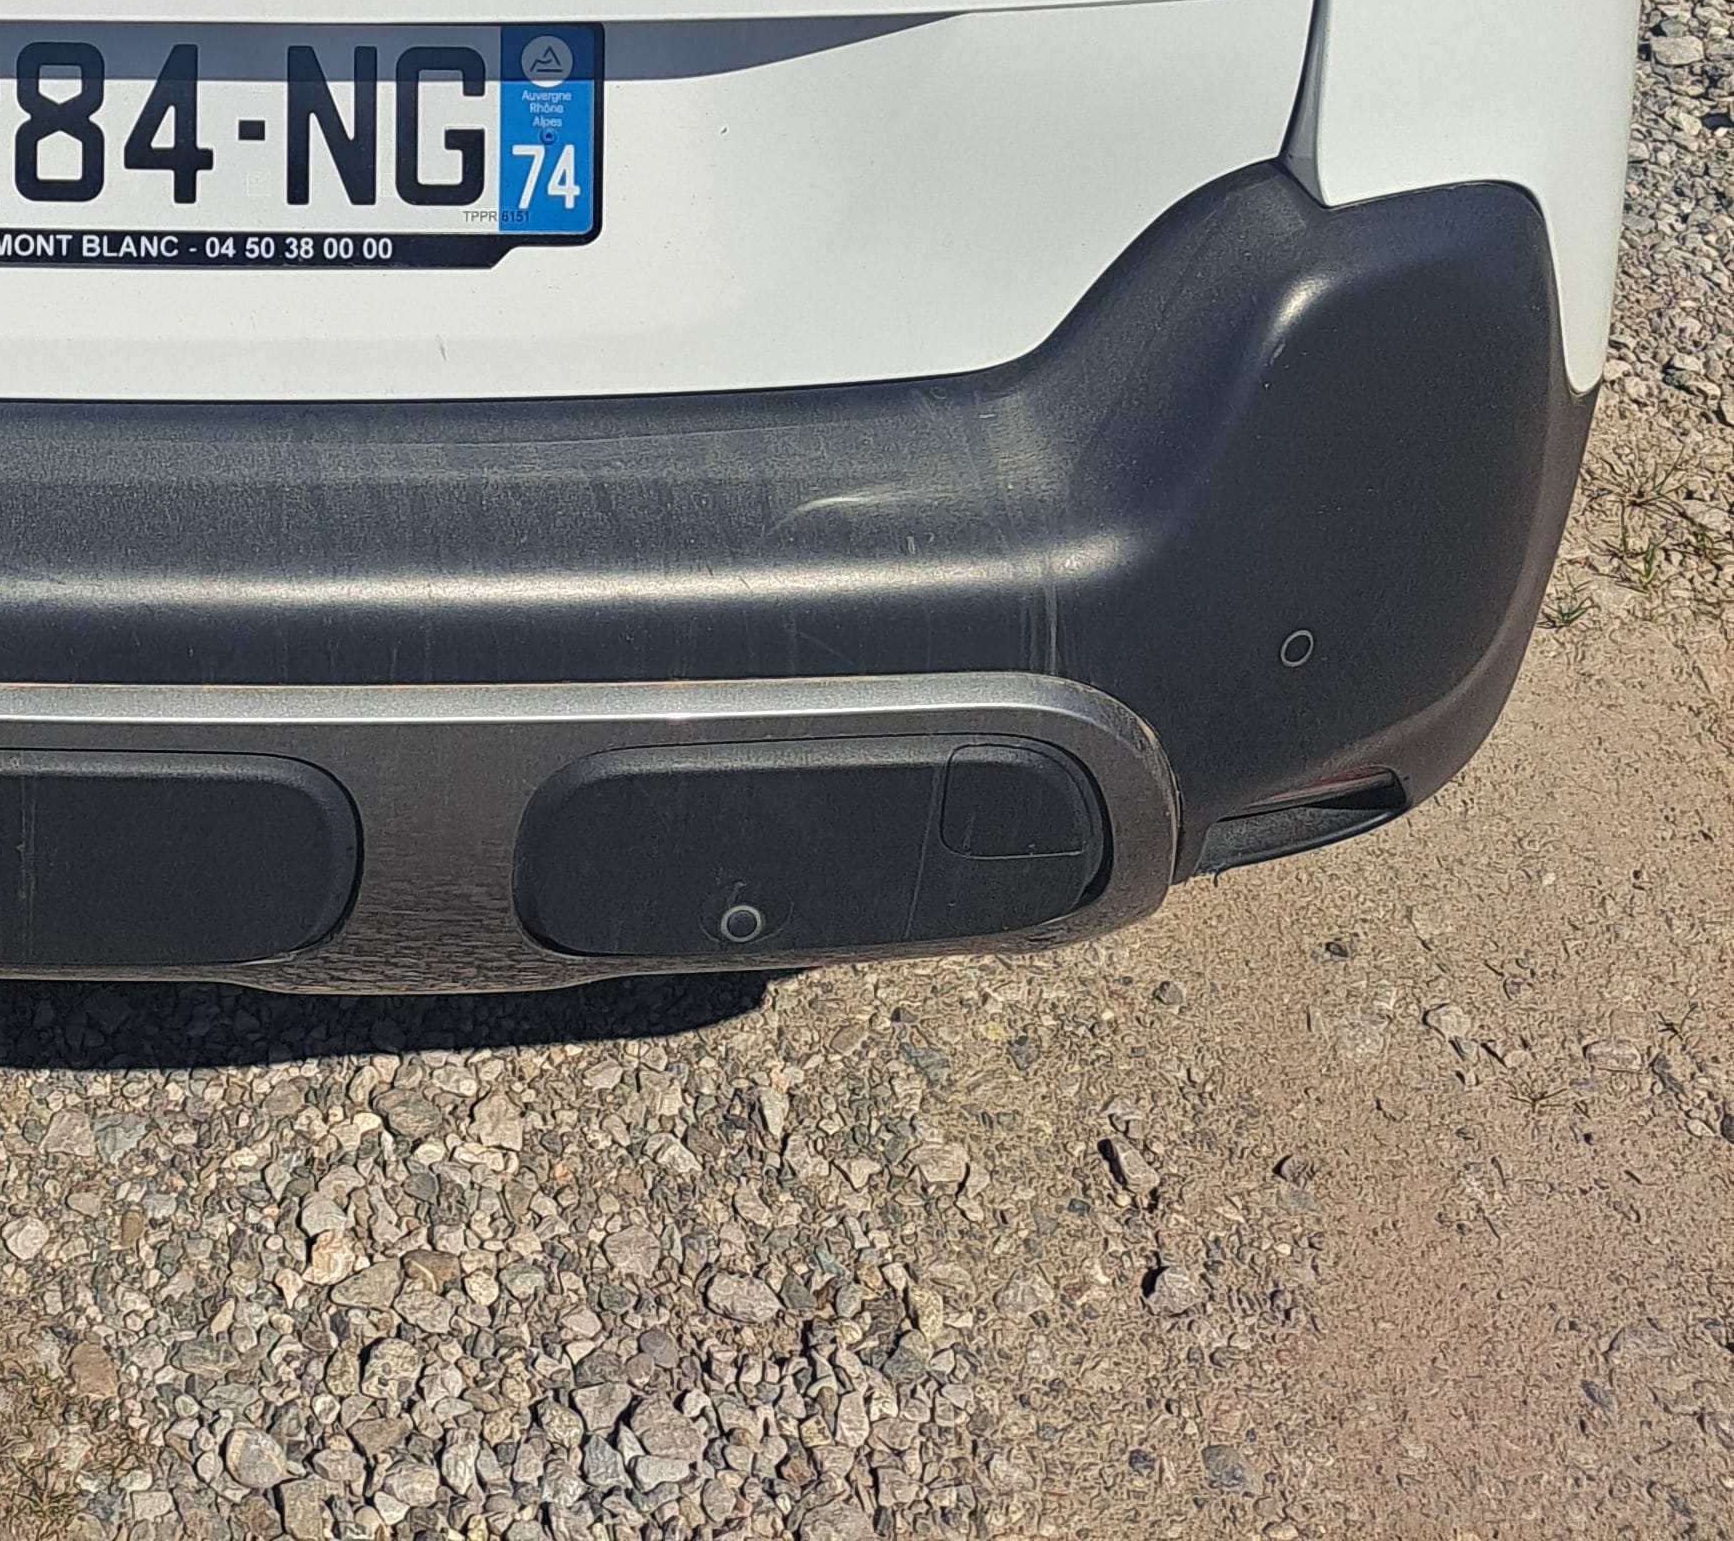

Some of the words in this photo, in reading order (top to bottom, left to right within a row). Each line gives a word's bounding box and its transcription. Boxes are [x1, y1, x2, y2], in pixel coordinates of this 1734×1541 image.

[522, 90, 572, 102] Auvergne
[530, 103, 564, 113] Rhône
[533, 116, 563, 127] Alpes
[512, 144, 580, 209] 74
[82, 235, 180, 258] BLANC
[205, 238, 236, 259] 04
[245, 238, 275, 259] 50
[284, 238, 314, 259] 38
[323, 238, 354, 259] 00
[362, 238, 393, 259] 00
